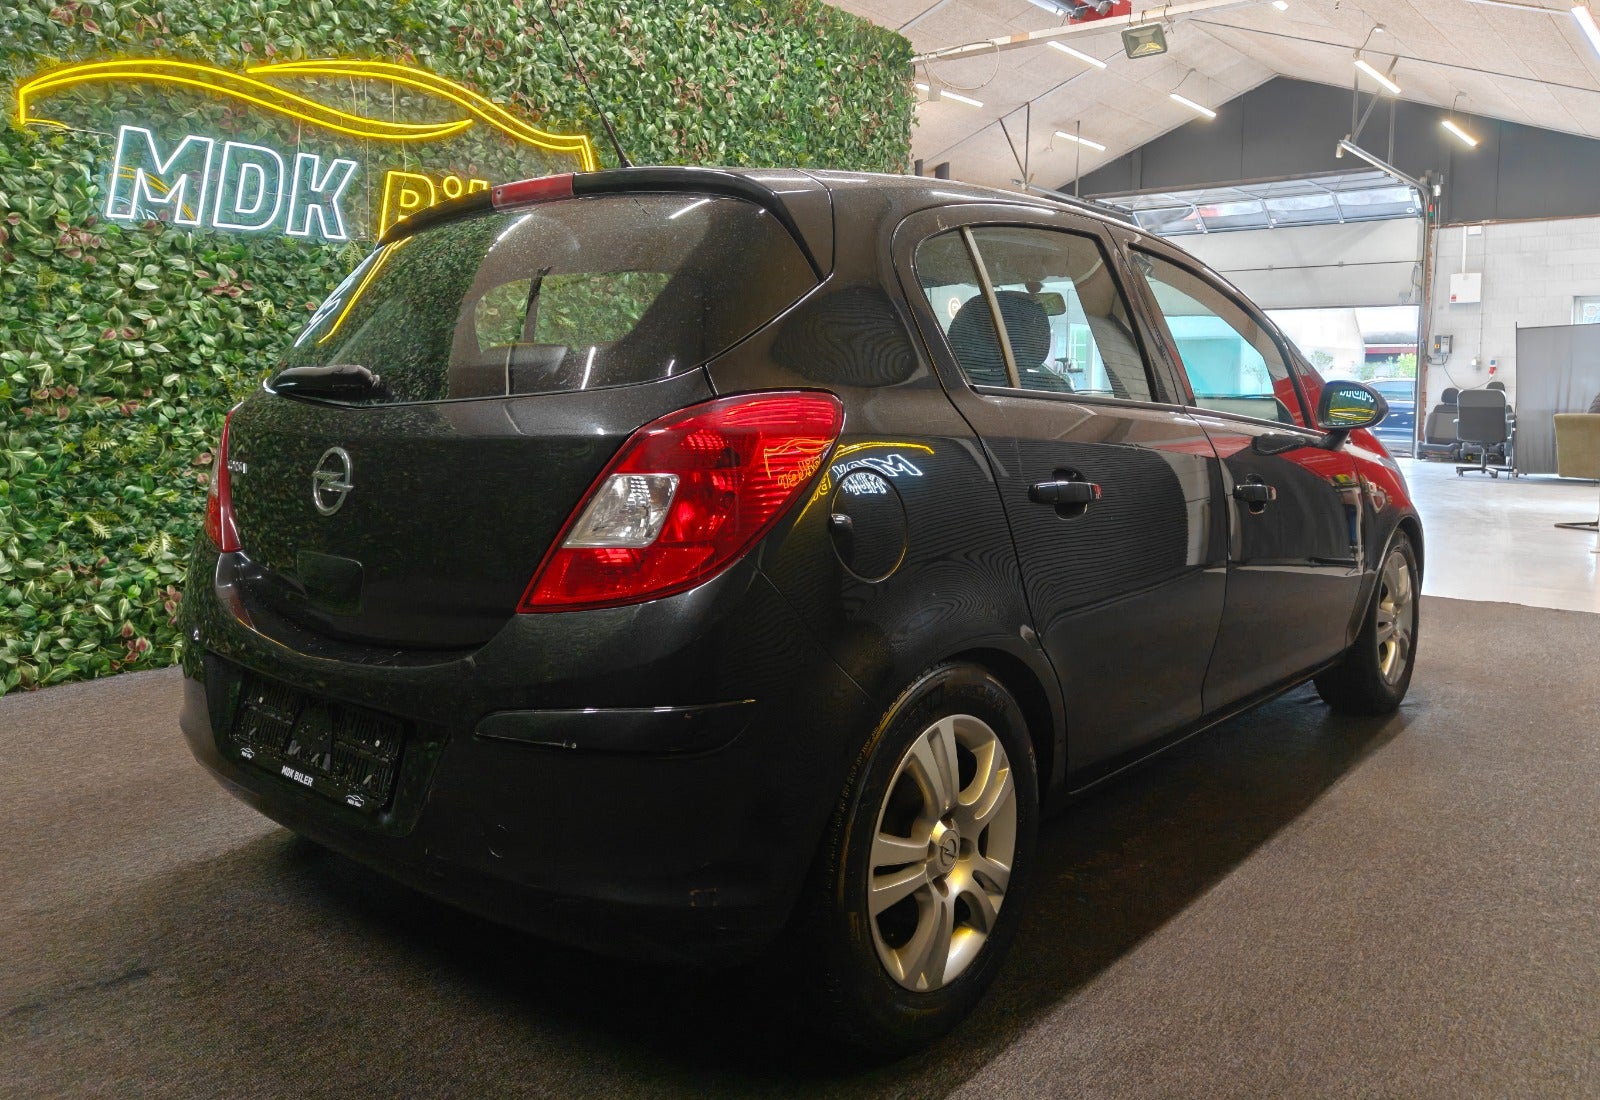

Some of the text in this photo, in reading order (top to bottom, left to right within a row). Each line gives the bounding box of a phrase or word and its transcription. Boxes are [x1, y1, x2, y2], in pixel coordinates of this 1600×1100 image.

[106, 125, 358, 240] MDK
[281, 765, 313, 787] MDK BILER
